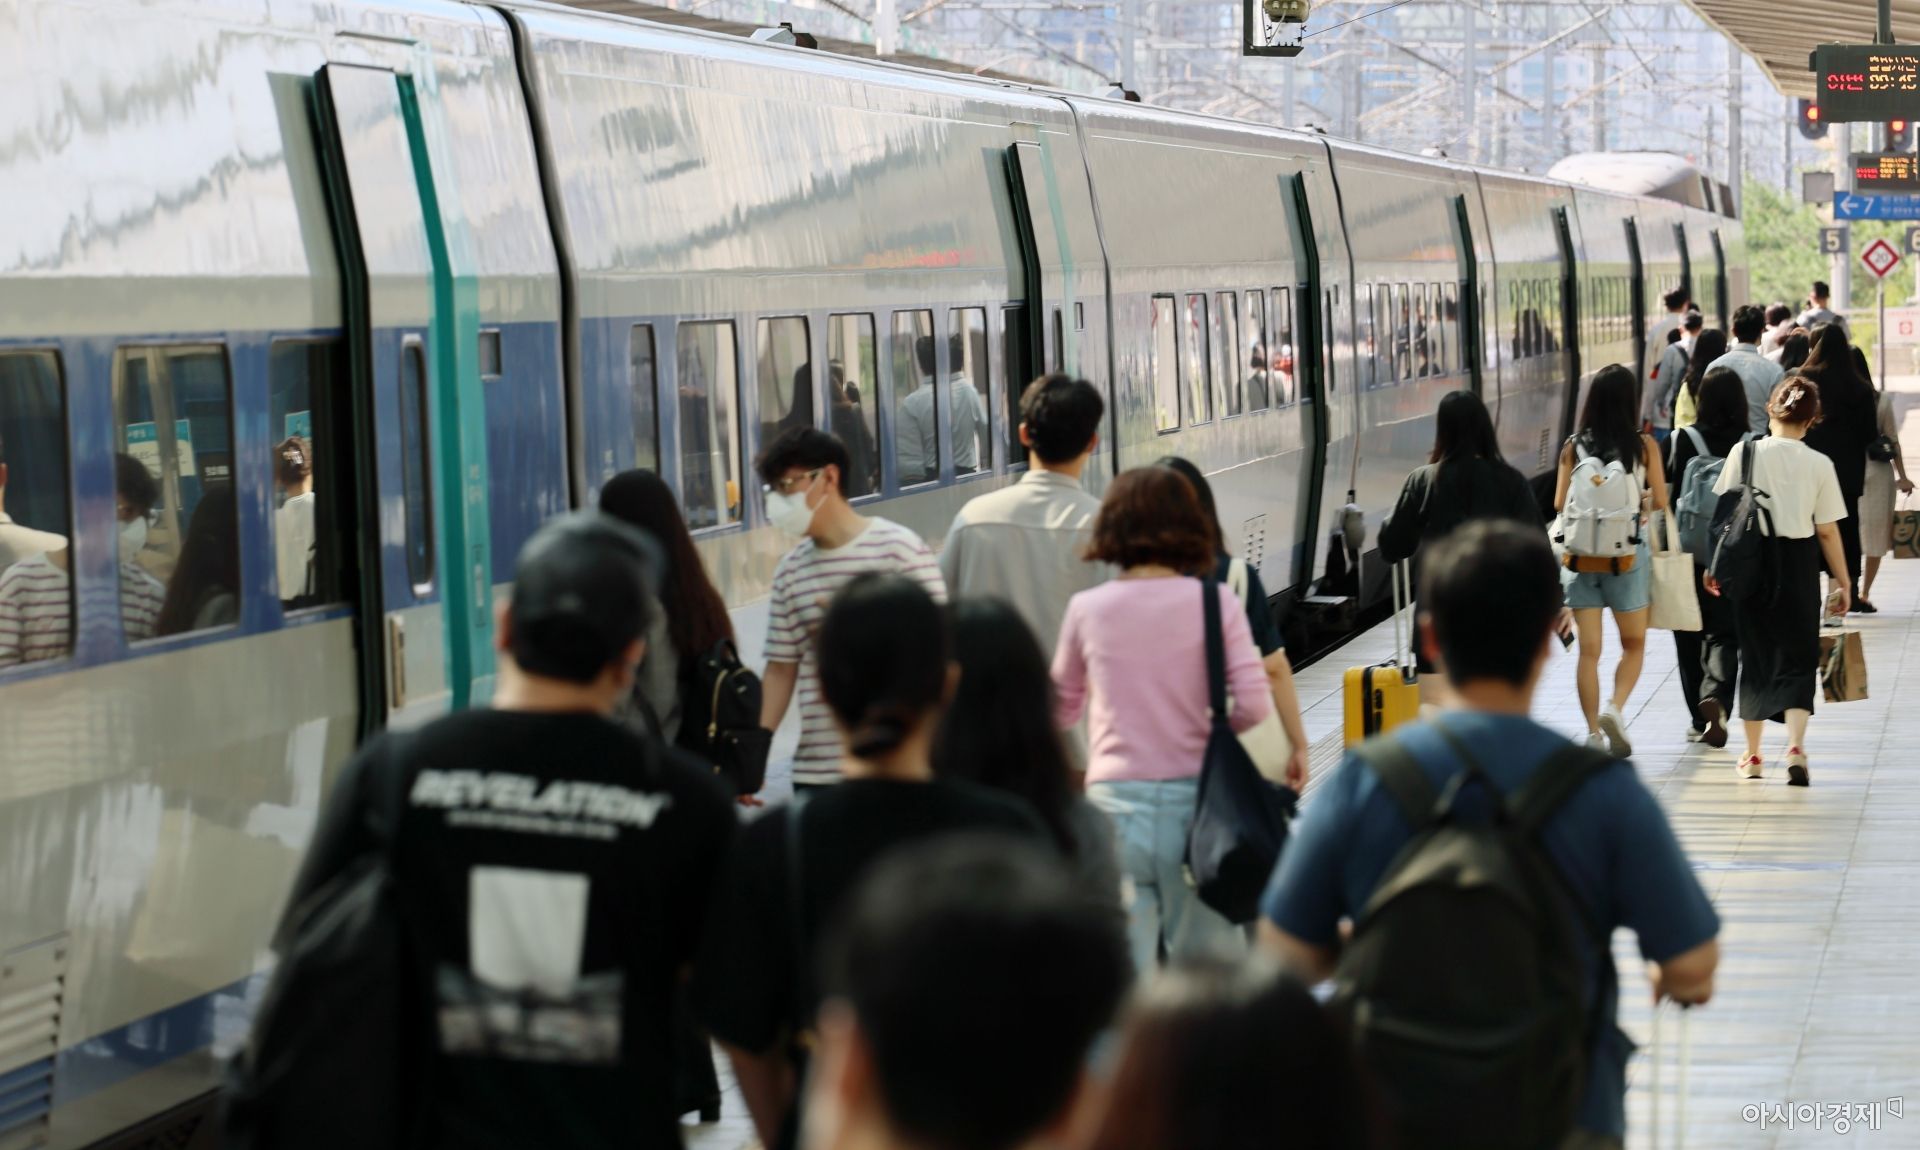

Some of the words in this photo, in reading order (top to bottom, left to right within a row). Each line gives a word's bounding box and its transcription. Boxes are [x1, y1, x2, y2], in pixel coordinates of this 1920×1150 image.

[1863, 197, 1875, 215] 7
[1825, 231, 1840, 251] 5
[1875, 252, 1889, 263] 20
[410, 769, 665, 829] REVELATION
